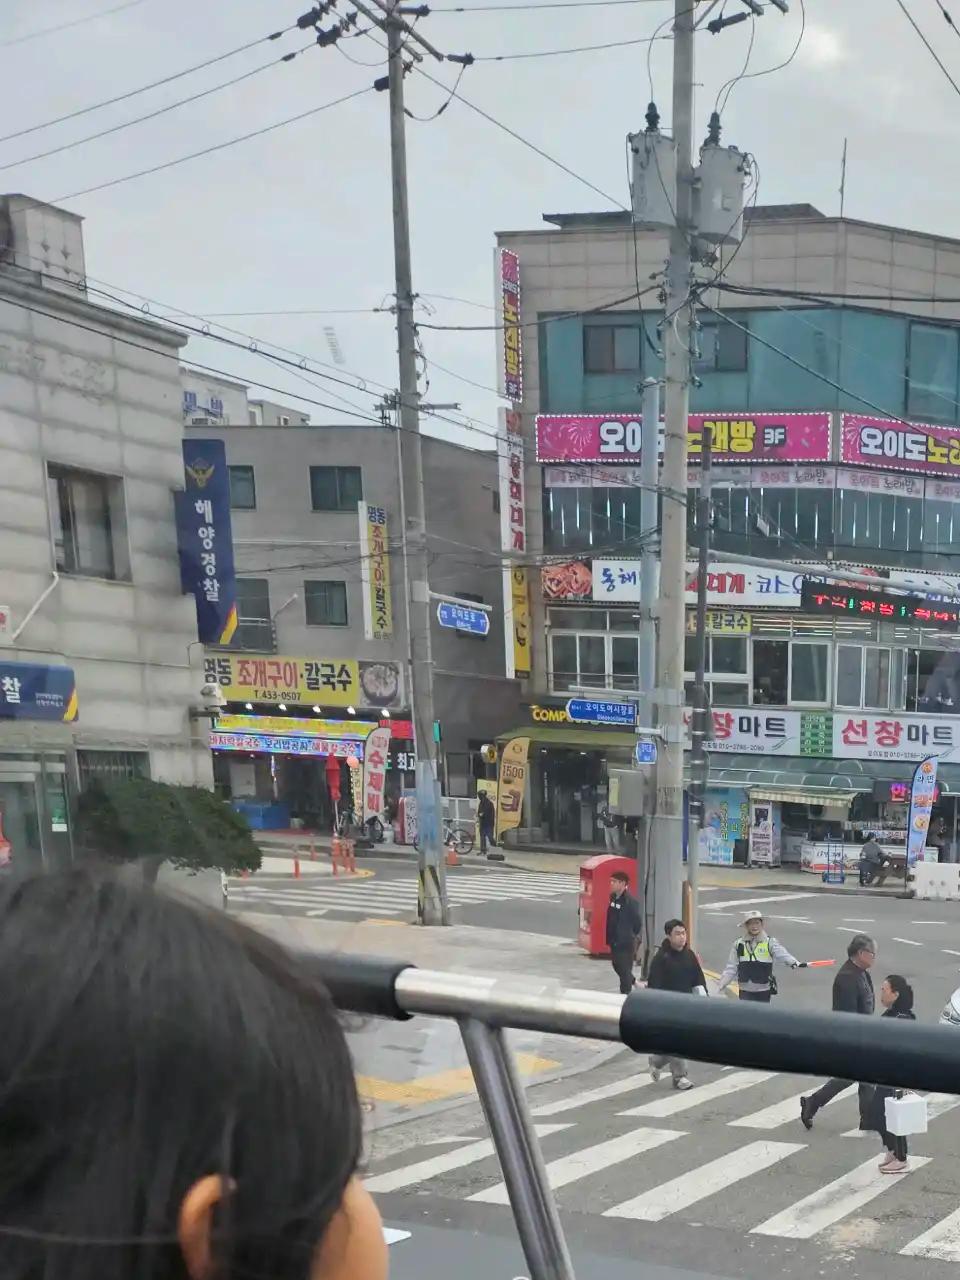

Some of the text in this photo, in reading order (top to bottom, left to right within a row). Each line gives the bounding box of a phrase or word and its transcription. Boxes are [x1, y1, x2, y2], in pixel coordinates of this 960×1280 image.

[763, 428, 786, 445] 3F
[194, 499, 221, 602] 해양경찰
[600, 568, 641, 593] 동해
[204, 658, 233, 686] 명동
[2, 676, 22, 704] 찰
[585, 702, 634, 716] 오이도어시장로
[841, 719, 954, 748] 선창마트
[365, 750, 384, 813] 수제비
